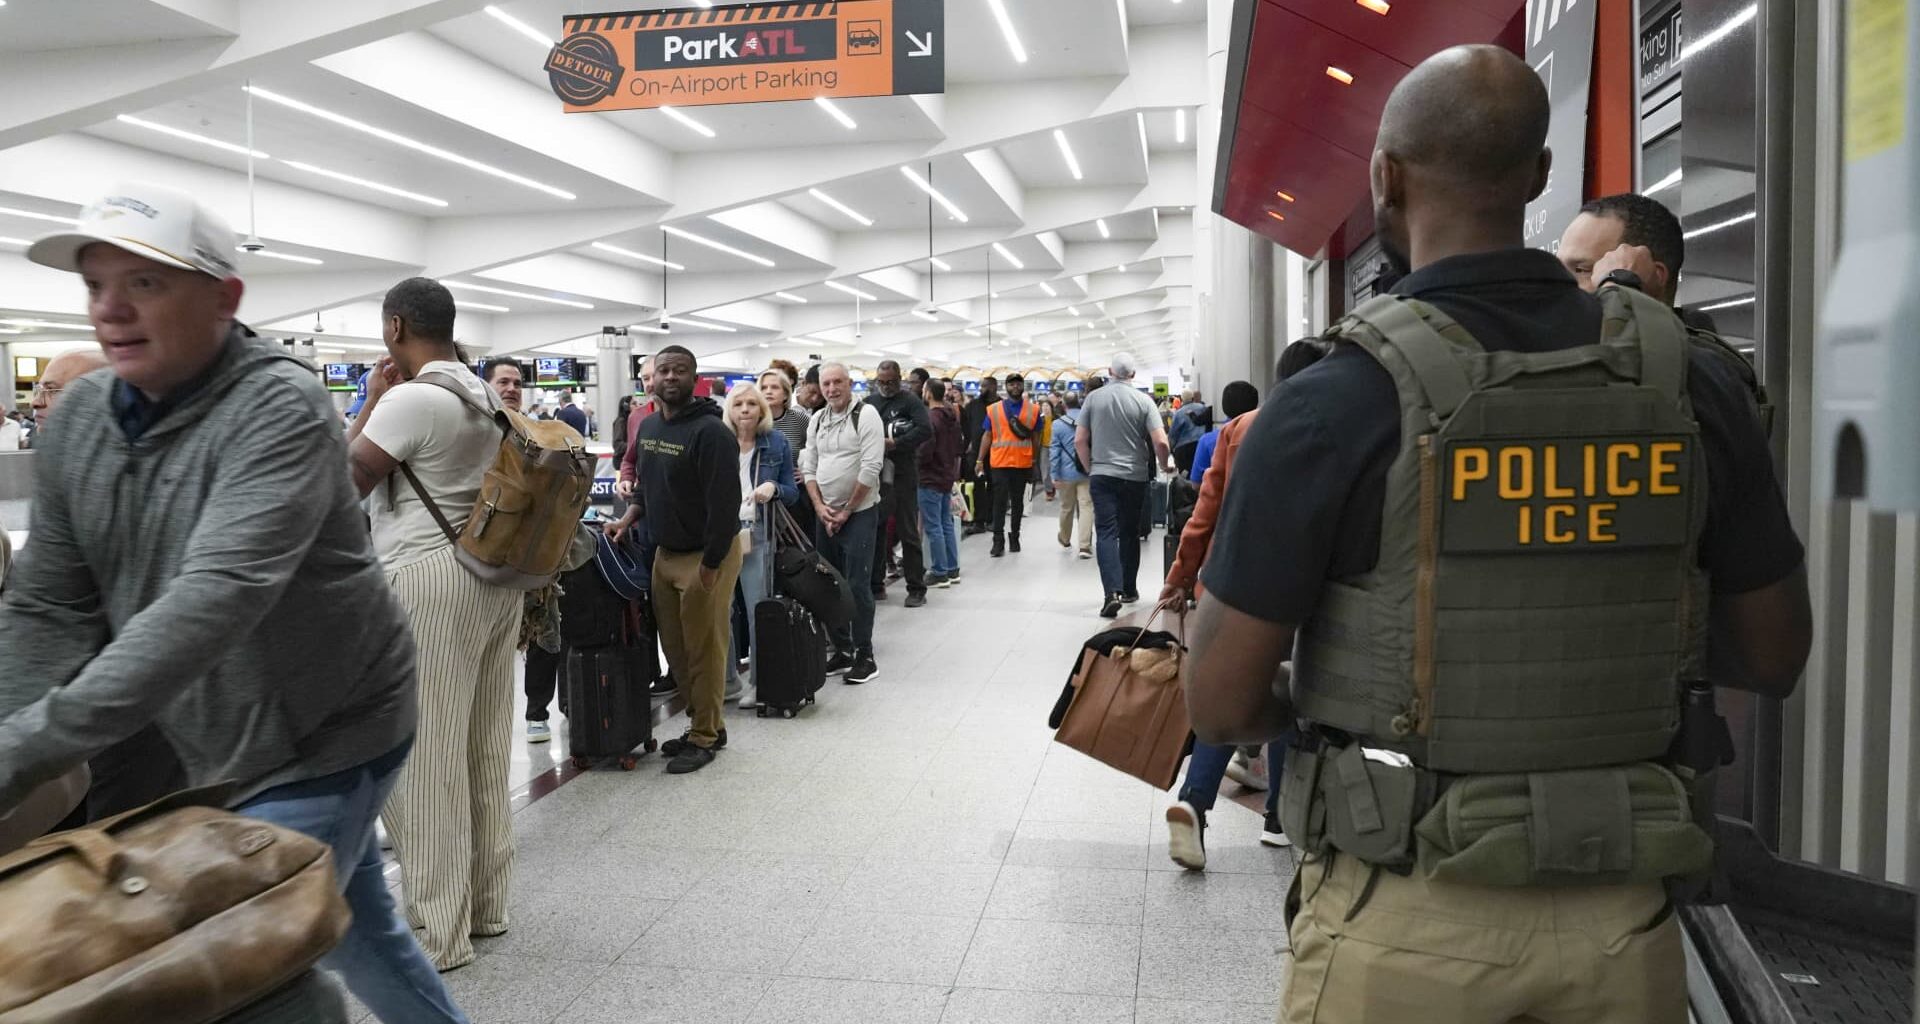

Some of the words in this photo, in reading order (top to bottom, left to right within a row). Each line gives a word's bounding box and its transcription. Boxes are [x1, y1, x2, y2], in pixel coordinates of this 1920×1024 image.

[664, 29, 807, 62] ParkATL
[556, 53, 613, 83] DETOUR
[630, 69, 747, 96] On-Airport
[755, 68, 838, 92] Parking
[1535, 209, 1547, 234] UP
[1453, 442, 1682, 501] POLICE
[590, 481, 611, 494] RST
[1519, 503, 1618, 544] ICE
